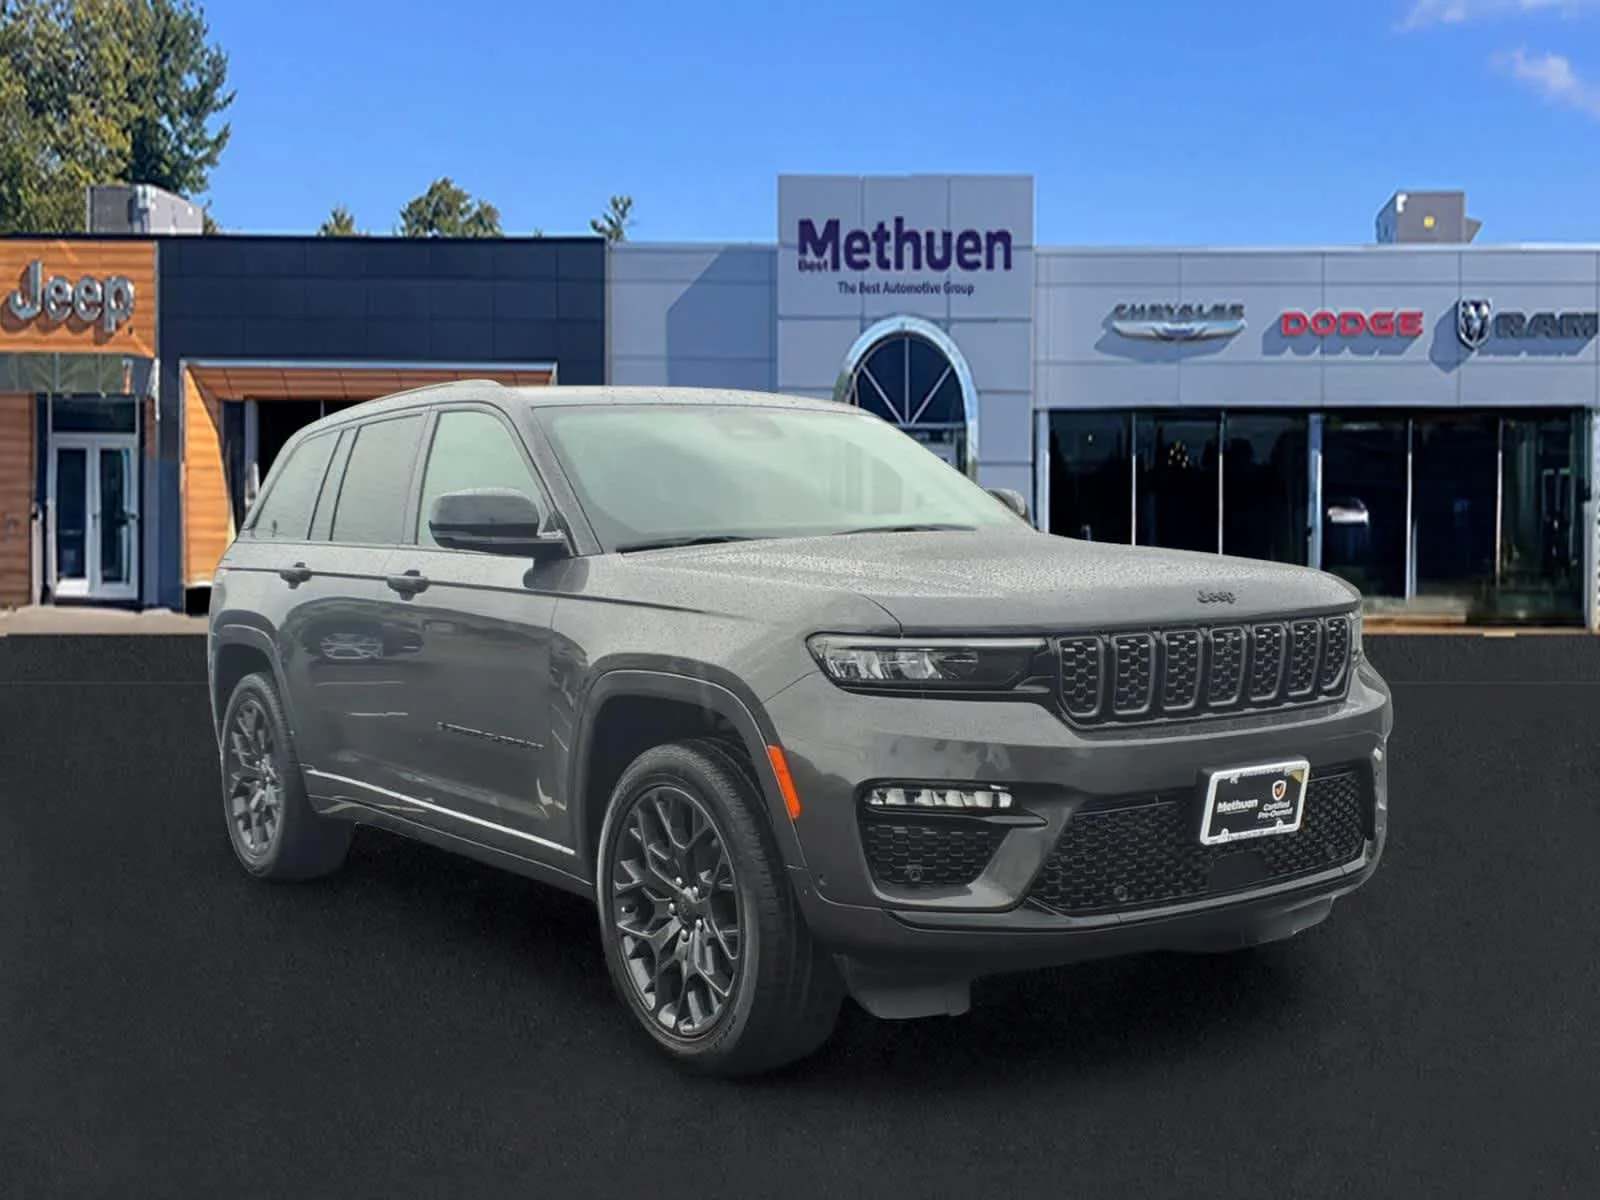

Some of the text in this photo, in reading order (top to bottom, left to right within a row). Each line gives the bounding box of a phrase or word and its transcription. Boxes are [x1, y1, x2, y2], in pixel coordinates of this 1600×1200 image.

[798, 216, 1012, 272] Methuen
[8, 260, 135, 333] Jeep
[837, 281, 975, 296] The Best Automotive Group
[1114, 303, 1244, 320] CHRYSLER
[1282, 311, 1424, 336] DODGE
[1495, 312, 1598, 338] RAM
[1197, 590, 1236, 604] Jeep
[1217, 799, 1258, 812] Methuen
